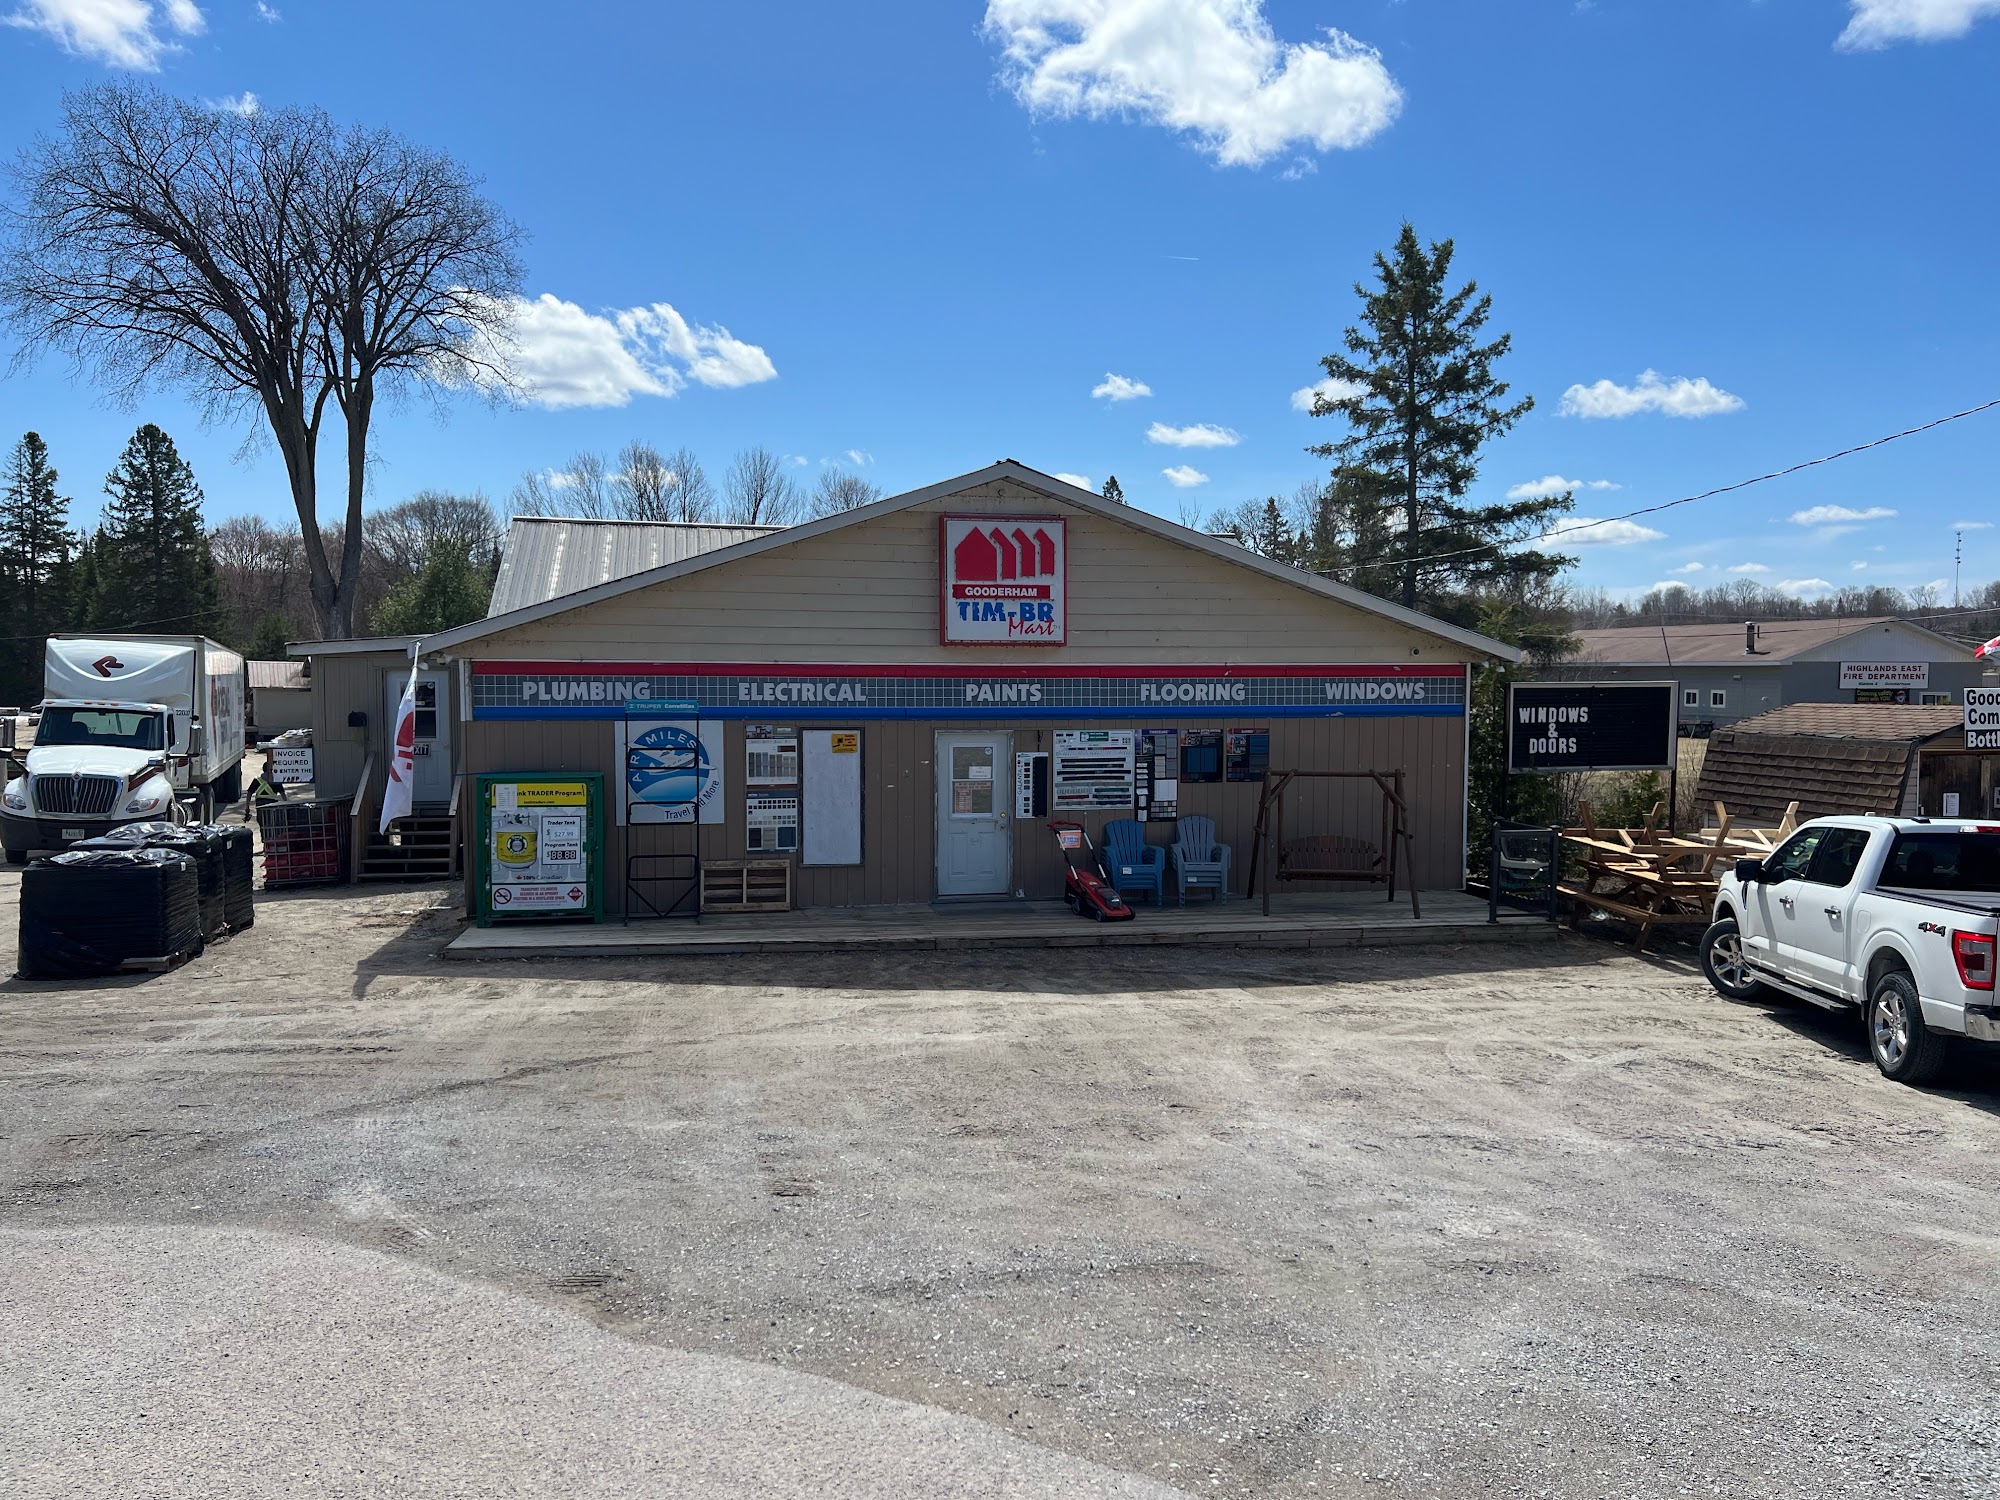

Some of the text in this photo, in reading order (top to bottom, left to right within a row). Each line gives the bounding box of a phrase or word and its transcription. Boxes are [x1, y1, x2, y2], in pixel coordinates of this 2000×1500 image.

[965, 587, 1037, 597] GOODERHAM
[957, 601, 1054, 622] TIM-BR
[1008, 615, 1055, 637] Mart
[522, 681, 1426, 702] PLUMBING ELECTRICAL PAINTS FLOORING WINDOWS
[1519, 707, 1589, 723] WINDOWS
[1548, 723, 1558, 737] &
[645, 731, 697, 749] MILES
[1529, 738, 1577, 754] DOORS
[555, 790, 582, 799] Program
[665, 806, 691, 820] Travel
[703, 780, 720, 801] More
